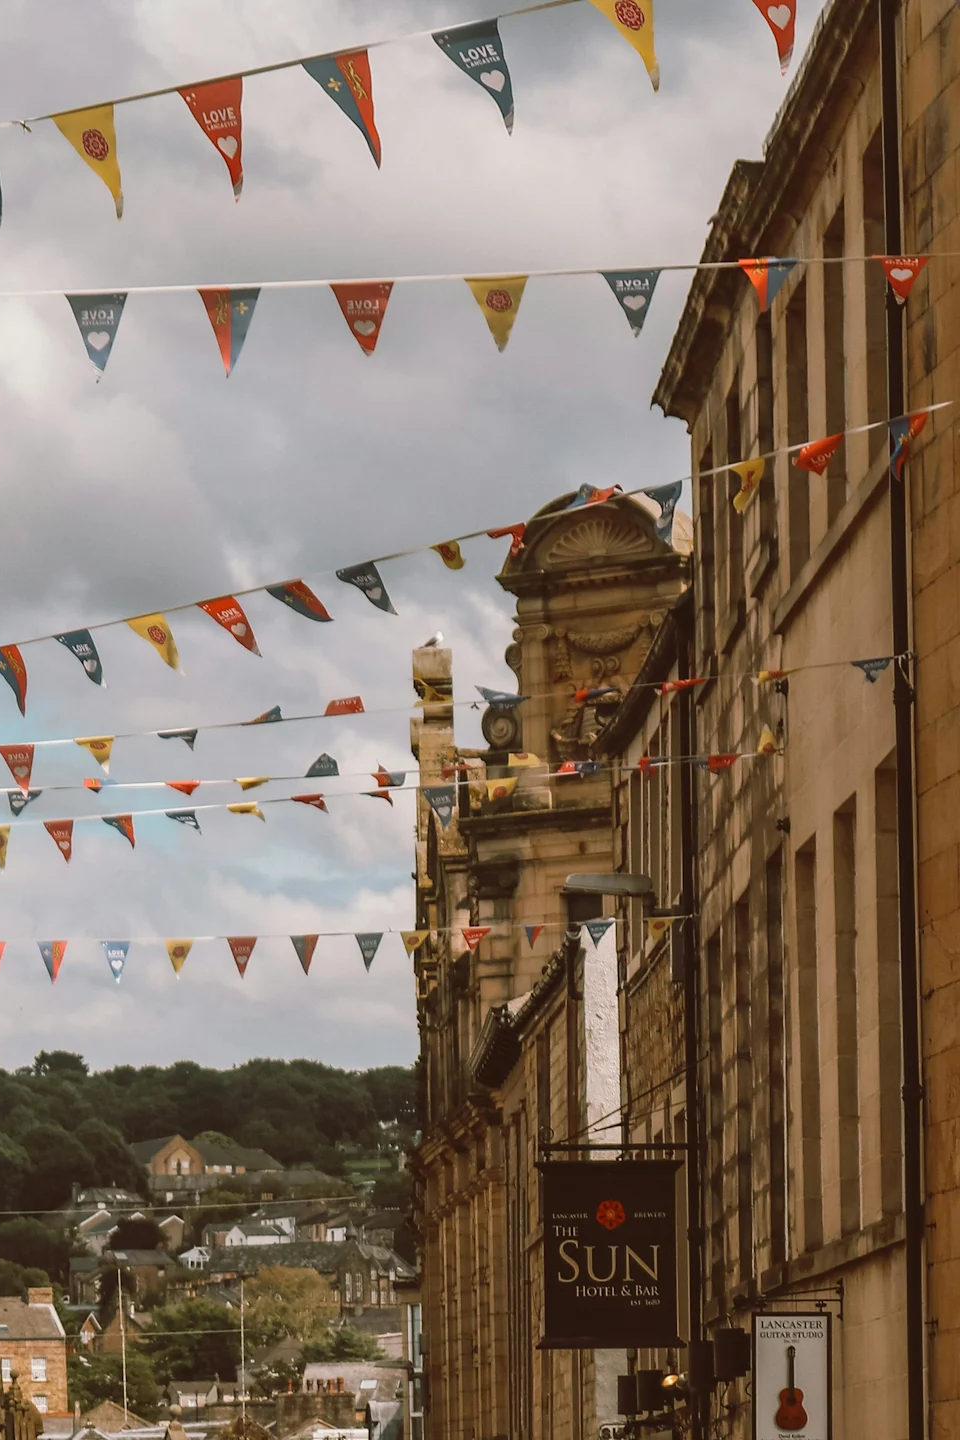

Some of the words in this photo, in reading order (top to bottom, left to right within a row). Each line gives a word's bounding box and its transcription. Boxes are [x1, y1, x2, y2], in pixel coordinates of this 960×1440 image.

[459, 44, 497, 65] LOVE
[202, 107, 236, 125] LOVE
[217, 607, 238, 619] LOVE
[553, 1225, 578, 1237] THE
[558, 1239, 660, 1283] SUN
[576, 1285, 617, 1297] HOTEL
[621, 1285, 631, 1296] &
[635, 1285, 659, 1296] BAR
[761, 1320, 823, 1329] LANCASTER
